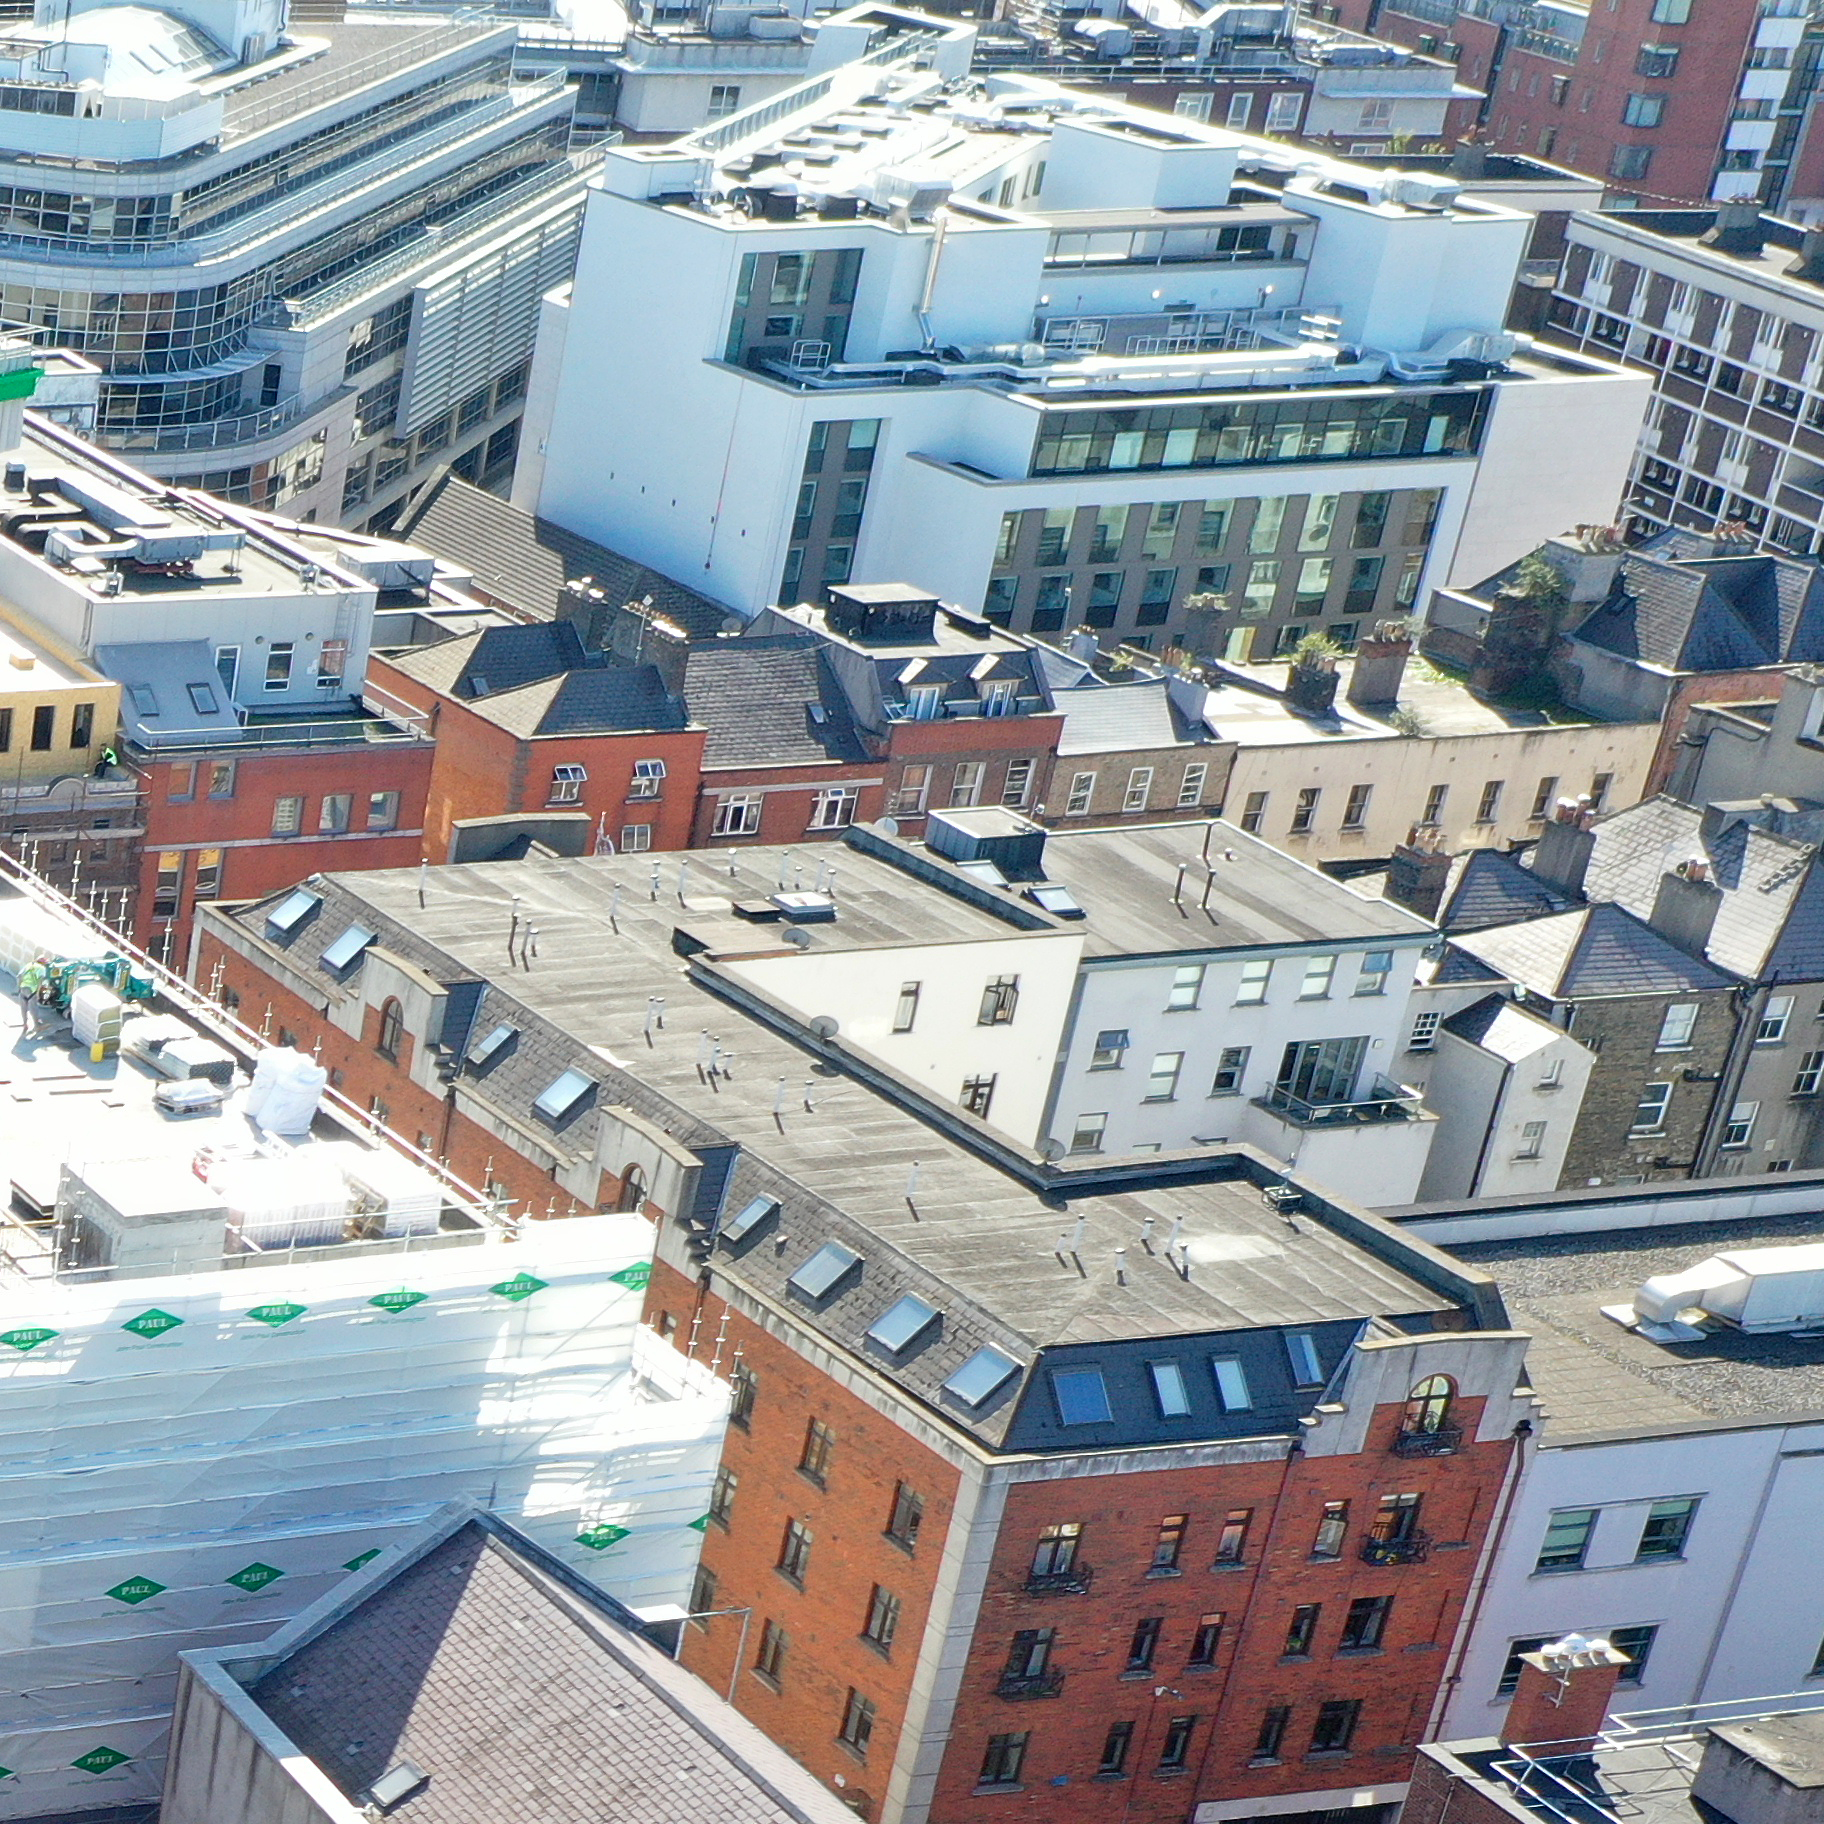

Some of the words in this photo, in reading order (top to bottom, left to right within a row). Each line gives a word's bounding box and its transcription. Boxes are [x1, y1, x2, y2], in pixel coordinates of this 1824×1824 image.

[262, 1306, 291, 1317] PAUL
[138, 1318, 168, 1329] PAUL
[13, 1331, 43, 1342] PAUL
[121, 1585, 151, 1596] PAUL
